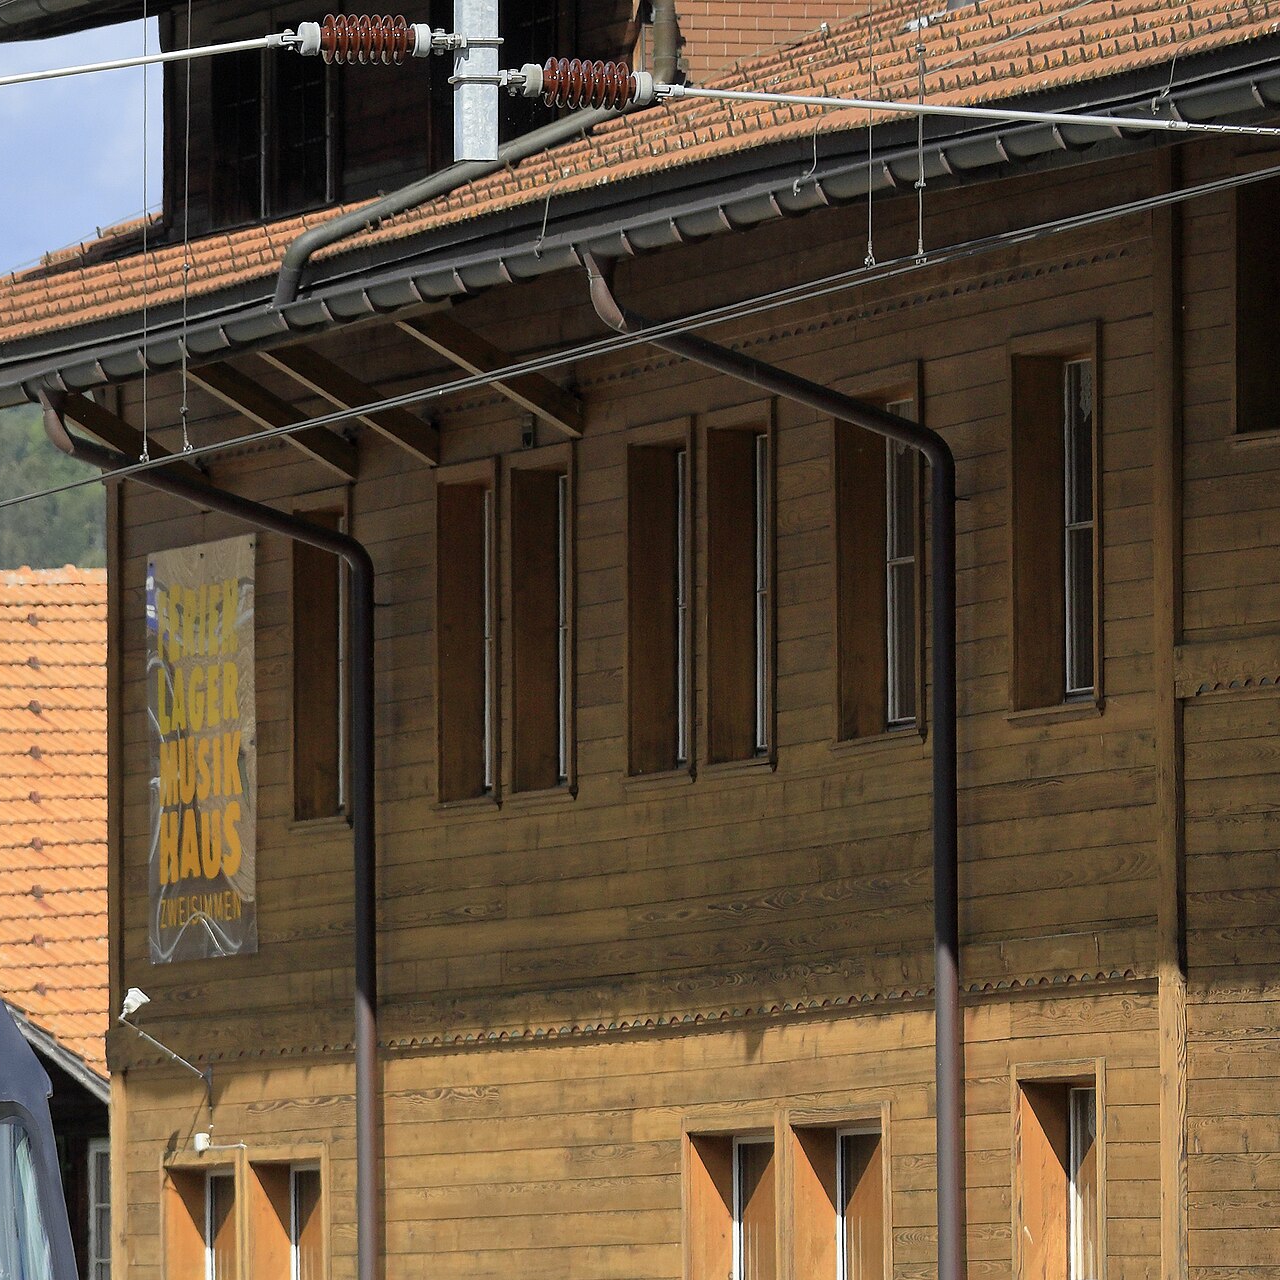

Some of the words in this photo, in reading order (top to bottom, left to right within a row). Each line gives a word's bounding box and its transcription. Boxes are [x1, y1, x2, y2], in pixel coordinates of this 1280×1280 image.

[157, 576, 239, 663] FERIEN
[157, 661, 239, 735] LAGER
[160, 731, 243, 807] MUSIK
[160, 801, 242, 885] HAUS
[160, 891, 241, 929] ZWEISIMMEN
